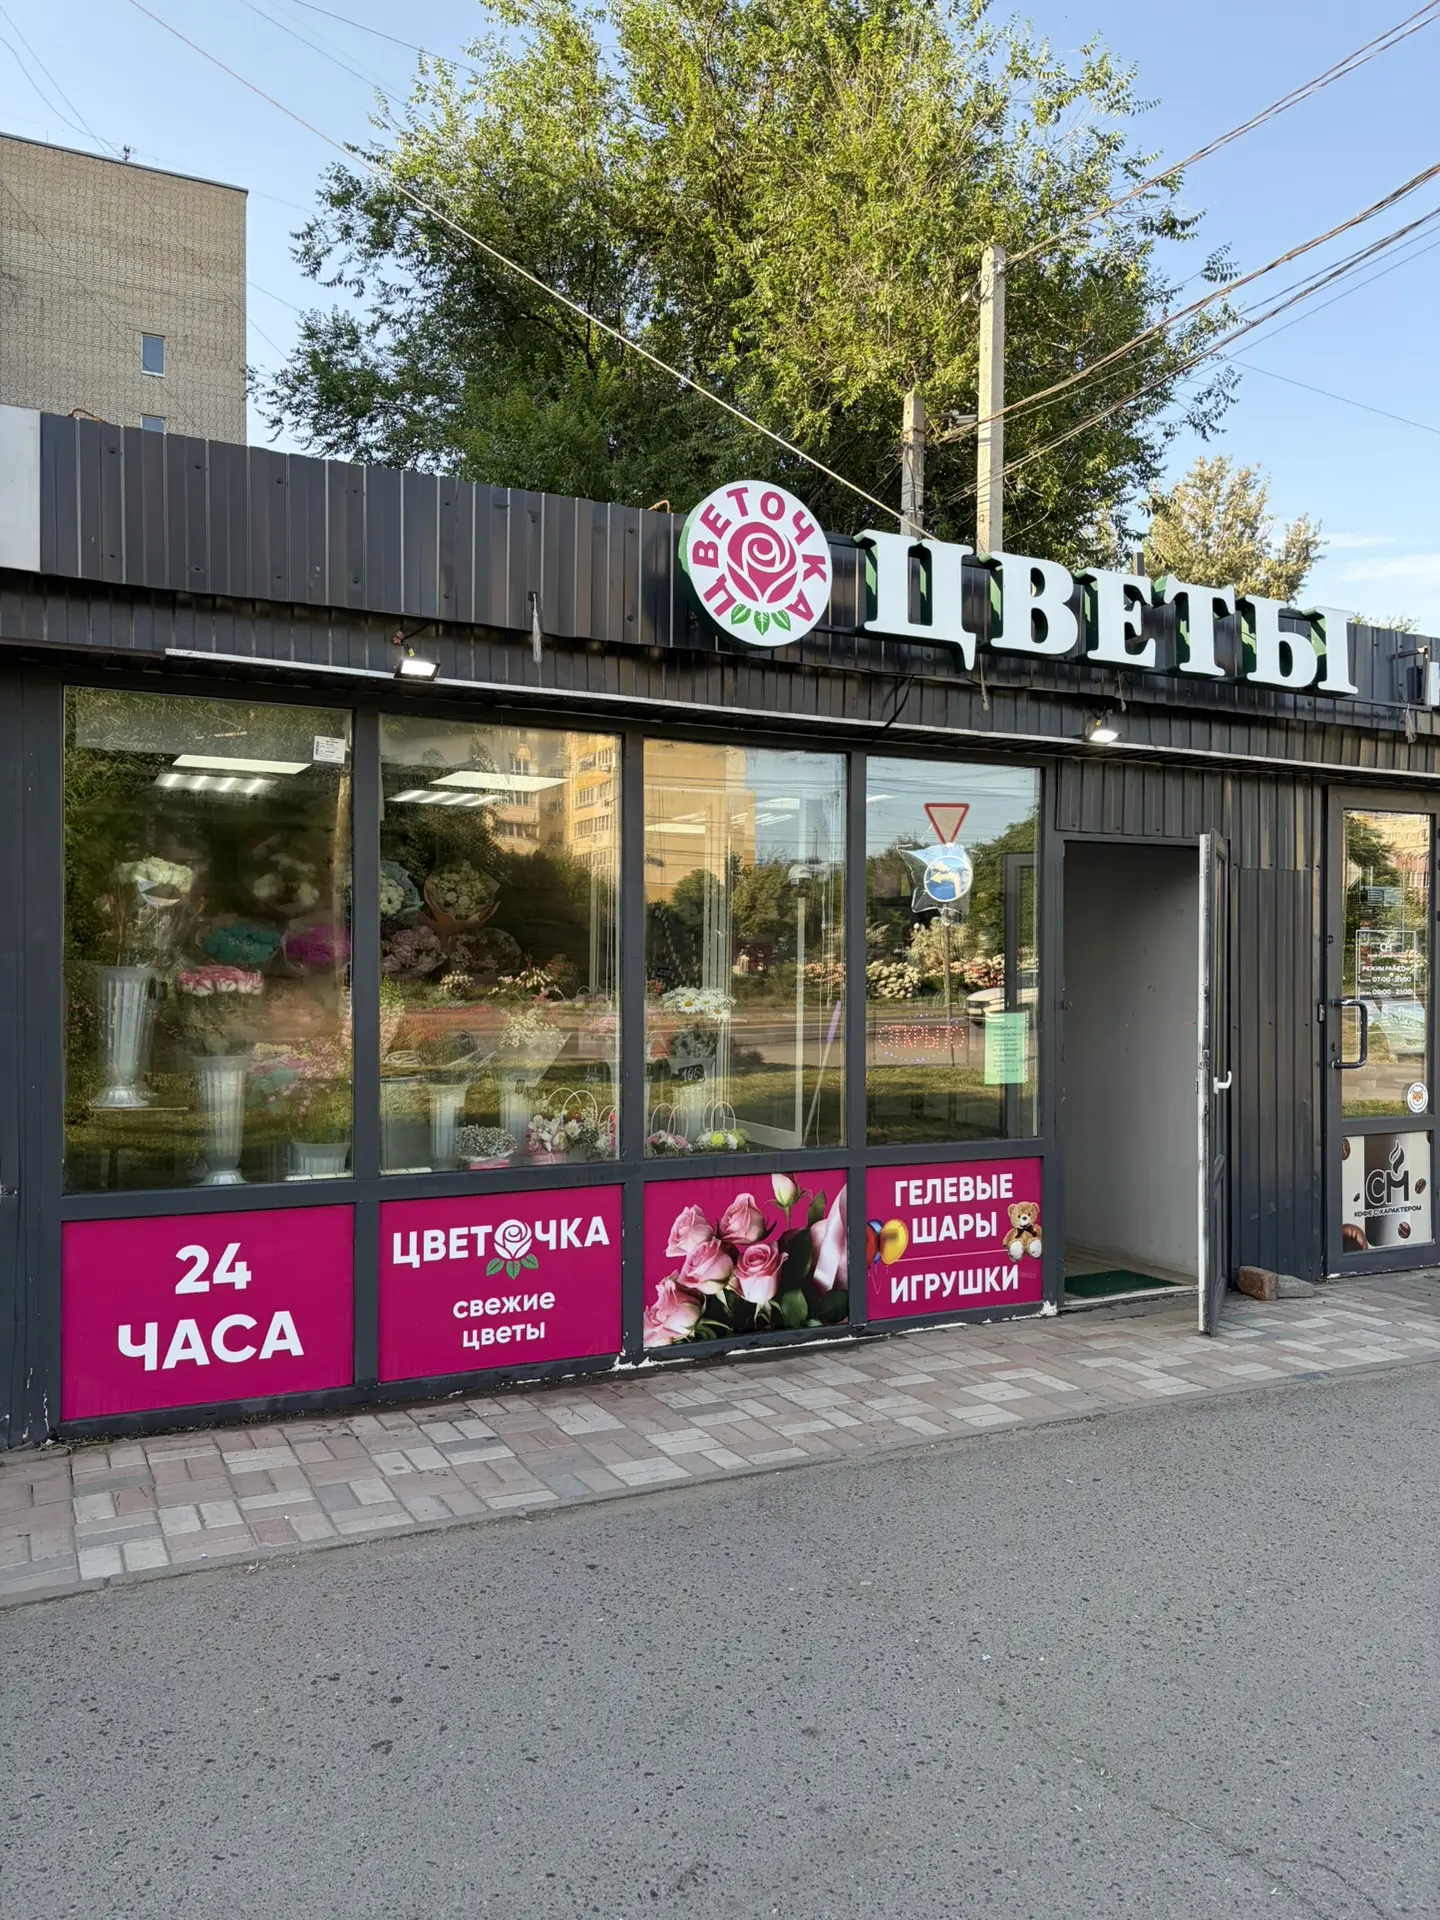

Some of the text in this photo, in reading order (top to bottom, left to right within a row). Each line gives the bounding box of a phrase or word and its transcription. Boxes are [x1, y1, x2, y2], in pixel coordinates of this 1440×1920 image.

[692, 487, 828, 624] ЦВЕТОЧКА
[862, 528, 1359, 695] ЦВЕТЫ
[878, 1025, 966, 1049] ОТКРЫТО
[894, 1173, 1014, 1207] ГЕЛЕВЫЕ
[911, 1211, 998, 1244] ШАРЫ
[1354, 1209, 1372, 1217] КОФЕ
[1379, 1205, 1422, 1215] ХАРАКТЕРОМ
[174, 1242, 252, 1295] 24
[890, 1264, 1020, 1304] ИГРУШКИ
[453, 1290, 556, 1320] свежие
[117, 1310, 305, 1372] ЧАСА
[461, 1321, 547, 1351] цветы
